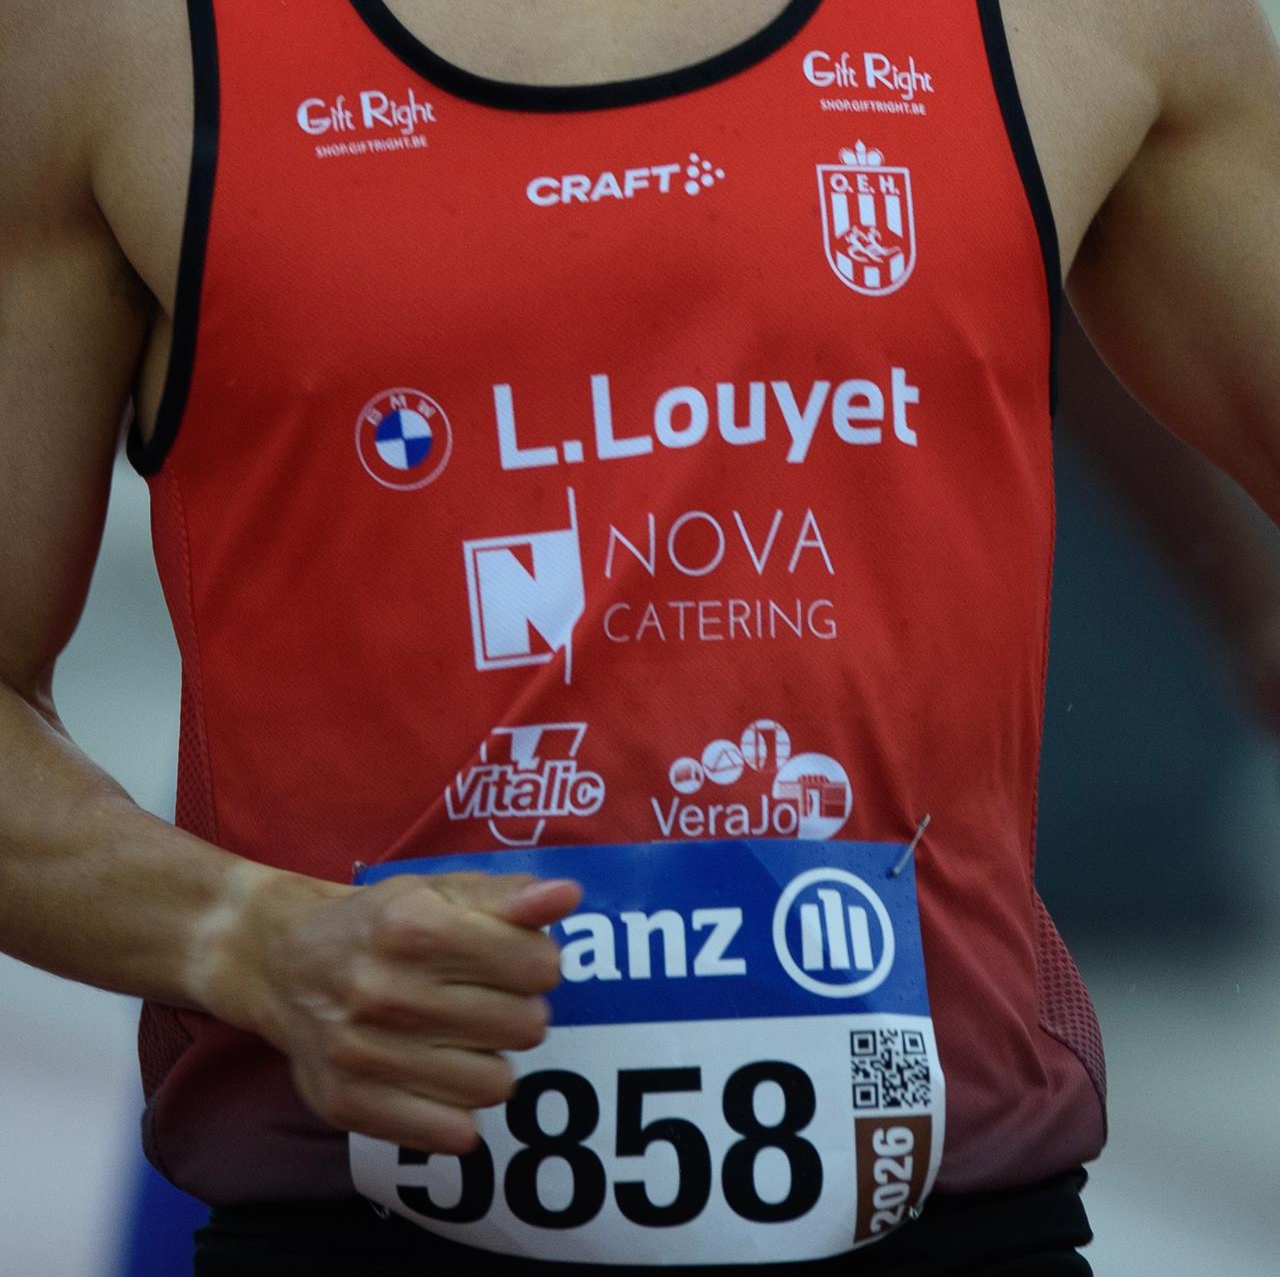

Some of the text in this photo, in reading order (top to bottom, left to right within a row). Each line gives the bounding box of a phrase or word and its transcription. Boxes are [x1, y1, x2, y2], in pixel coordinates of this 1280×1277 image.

[803, 49, 934, 101] Gift Right
[296, 87, 437, 135] Gift Right
[526, 164, 680, 207] CRAFT
[492, 366, 920, 472] L.Louyet
[605, 508, 836, 579] NOVA
[604, 599, 838, 643] CATERING
[444, 759, 606, 821] Vitalic
[650, 794, 798, 837] VeraJo
[870, 1126, 915, 1234] 2026
